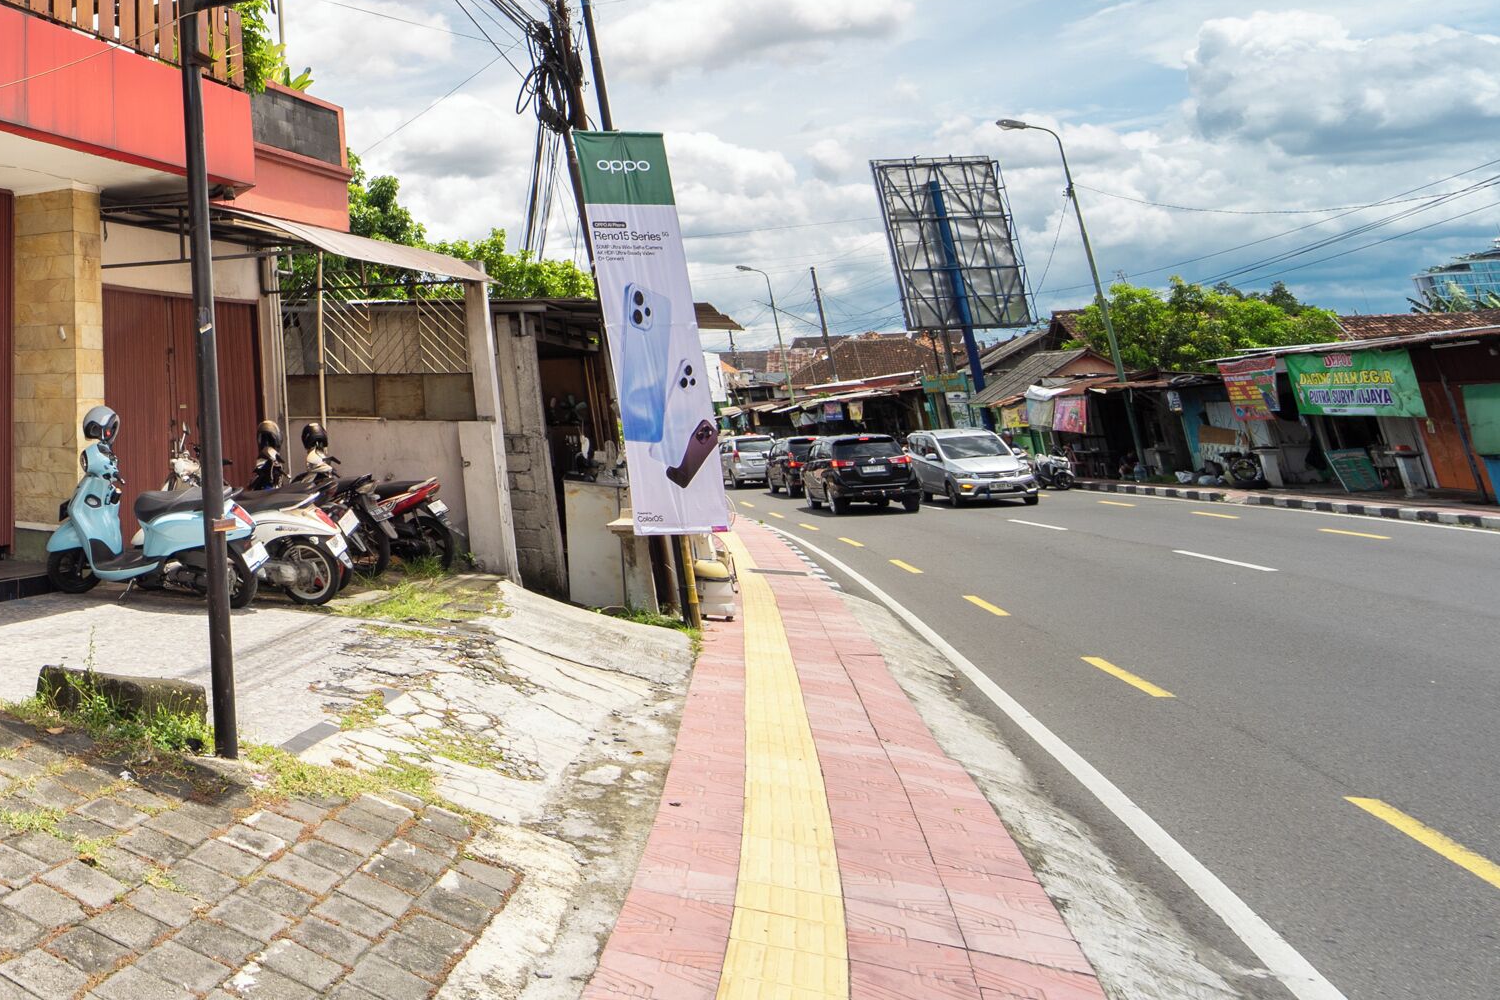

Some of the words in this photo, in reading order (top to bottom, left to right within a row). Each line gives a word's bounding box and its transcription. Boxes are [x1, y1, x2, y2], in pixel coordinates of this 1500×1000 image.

[596, 160, 650, 174] oppo
[593, 230, 629, 241] Reno15
[630, 231, 661, 241] Series
[1299, 372, 1331, 385] DAGING
[1308, 389, 1331, 404] PUTRA
